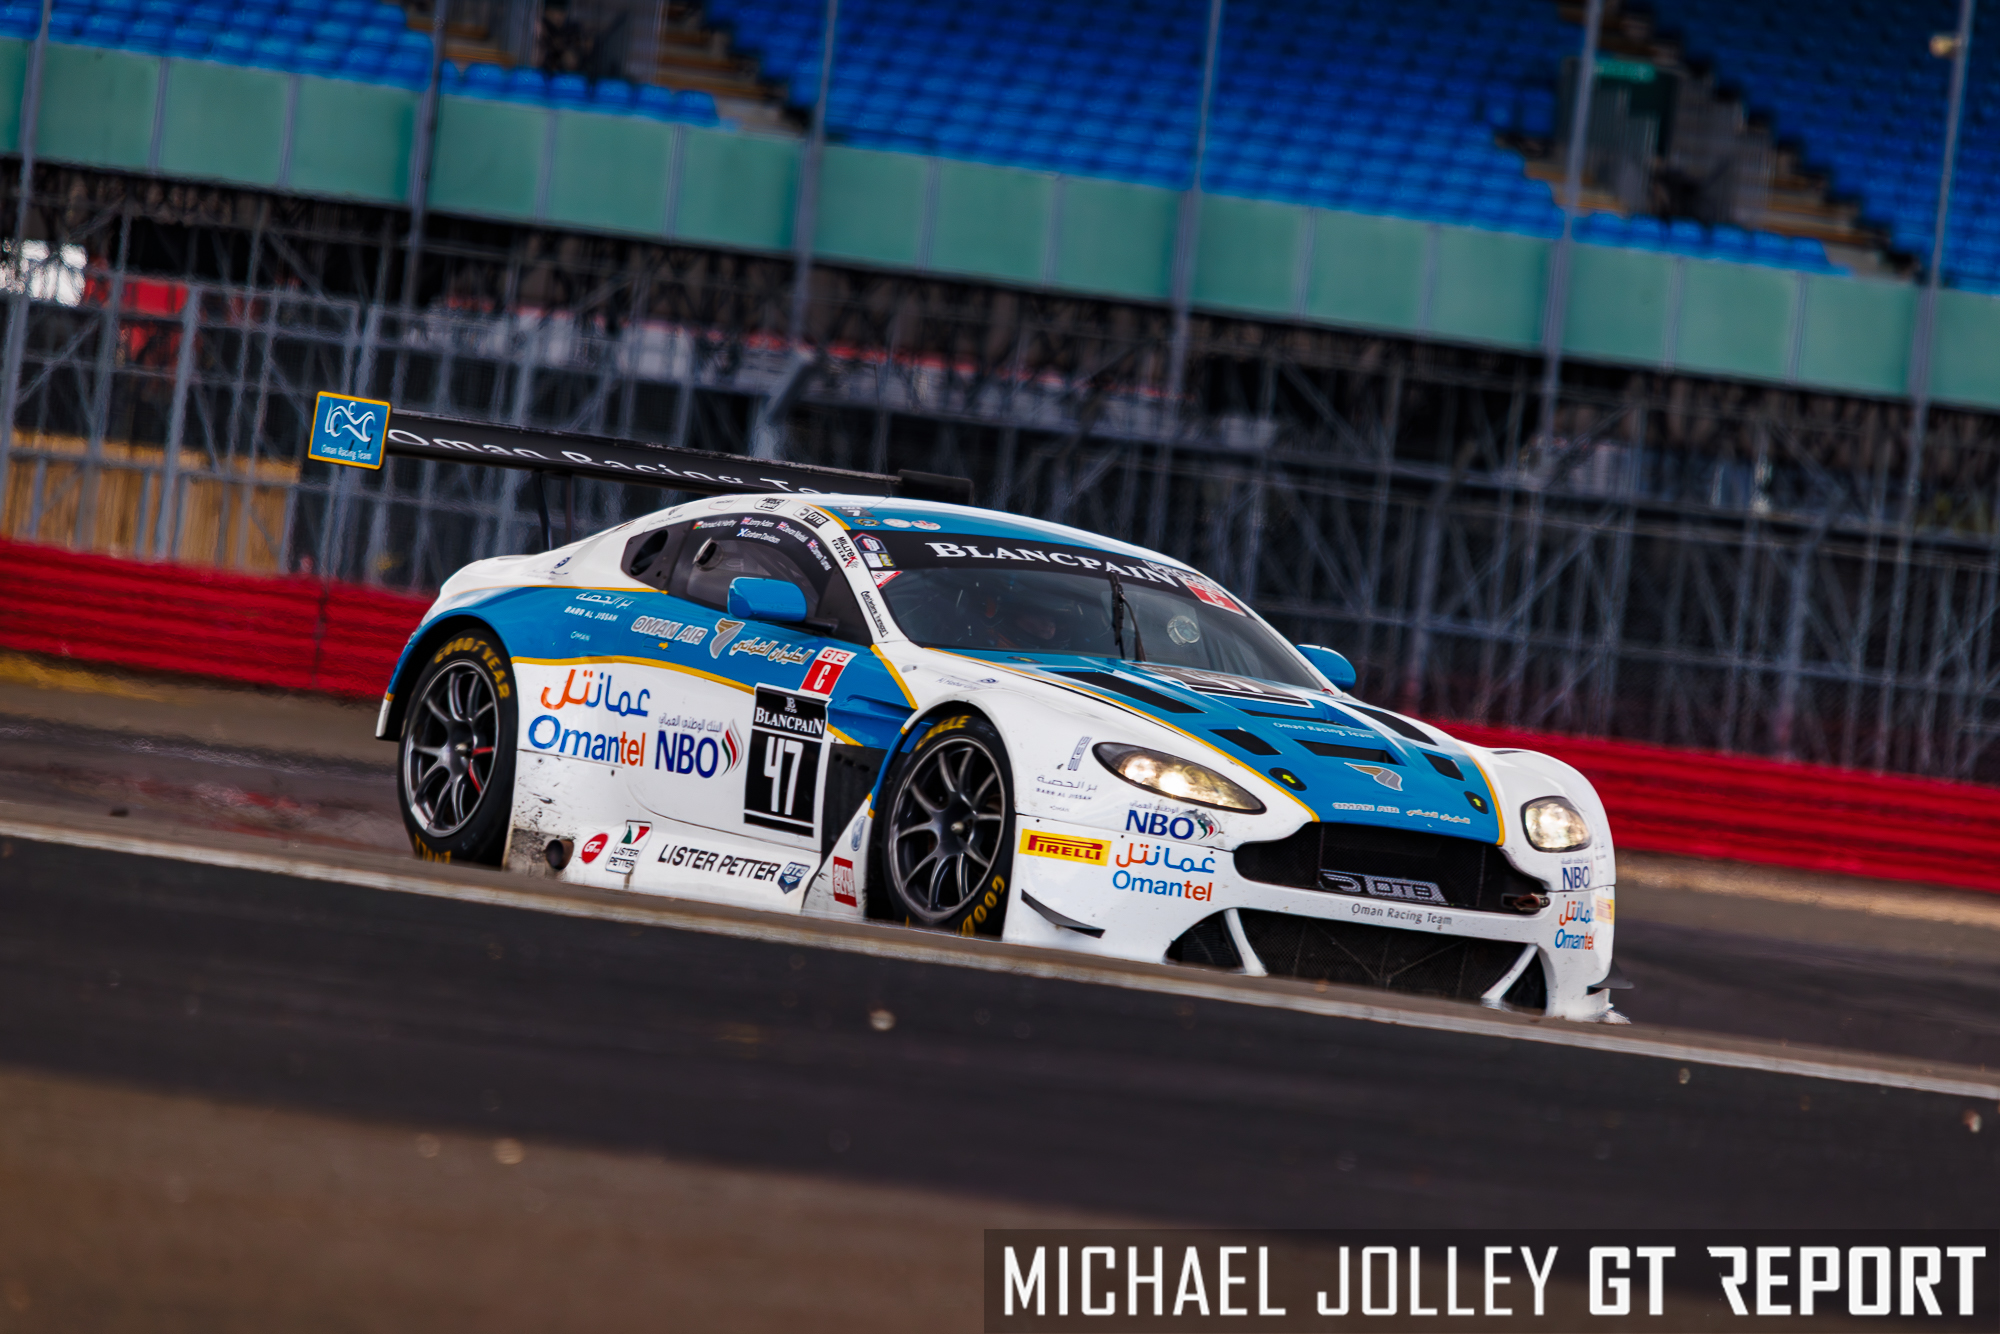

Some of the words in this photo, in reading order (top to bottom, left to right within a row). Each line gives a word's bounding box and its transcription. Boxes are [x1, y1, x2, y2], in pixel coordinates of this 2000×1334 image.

[321, 444, 337, 455] Oman
[338, 447, 357, 460] Racing
[358, 450, 372, 460] Team
[388, 429, 549, 460] Oman
[924, 542, 1179, 588] BLANCPAIN
[564, 606, 585, 616] BARR
[594, 612, 619, 622] JISSAH
[631, 615, 683, 639] OMAN
[674, 625, 709, 646] AIR
[822, 650, 850, 663] GT3
[813, 664, 832, 691] C
[540, 668, 651, 718] عمانتل
[754, 706, 825, 735] BLANCPAIN
[1272, 722, 1306, 731] Oman
[1306, 725, 1346, 737] Racing
[1345, 731, 1375, 740] Team
[528, 714, 647, 767] Omantel
[655, 729, 719, 779] NBO
[763, 735, 805, 816] 47
[1035, 787, 1055, 796] BARR
[1068, 793, 1092, 801] JISSAH
[1332, 802, 1375, 811] OMAN
[1376, 805, 1400, 814] AIR
[1125, 809, 1195, 841] NBO
[613, 846, 640, 858] LISTER
[1027, 834, 1103, 861] PIRELLI
[1115, 843, 1216, 874] عمانتل
[608, 856, 636, 868] PETTER
[657, 843, 718, 872] LISTER
[716, 856, 782, 882] PETTER
[783, 863, 809, 877] GT3
[1112, 870, 1213, 902] Omantel
[1562, 866, 1590, 890] NBO
[1351, 903, 1384, 916] Oman
[1387, 907, 1423, 924] Racing
[1426, 912, 1453, 925] Team
[1555, 929, 1595, 950] Omantel
